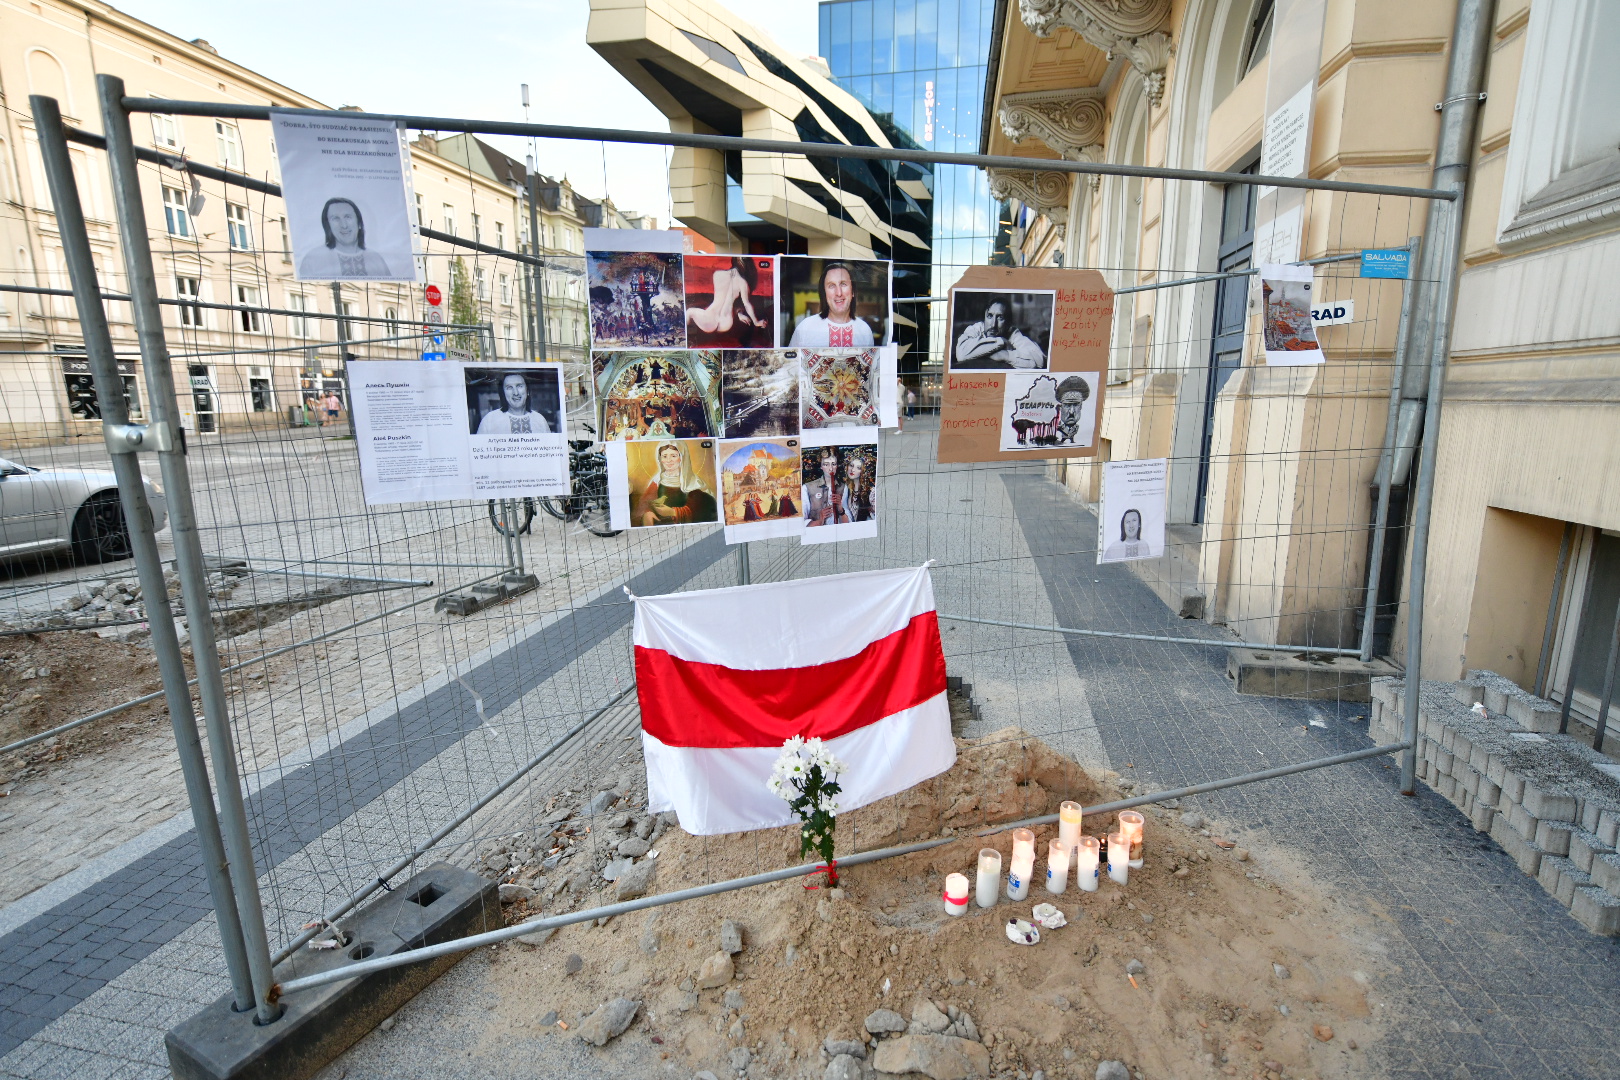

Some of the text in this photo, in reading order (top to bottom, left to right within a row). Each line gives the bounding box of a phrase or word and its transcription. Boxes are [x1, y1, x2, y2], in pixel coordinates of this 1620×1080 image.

[924, 81, 934, 142] BOWLING
[1057, 289, 1076, 302] Aleś
[948, 376, 999, 390] Łukaszenko
[952, 394, 976, 410] jest
